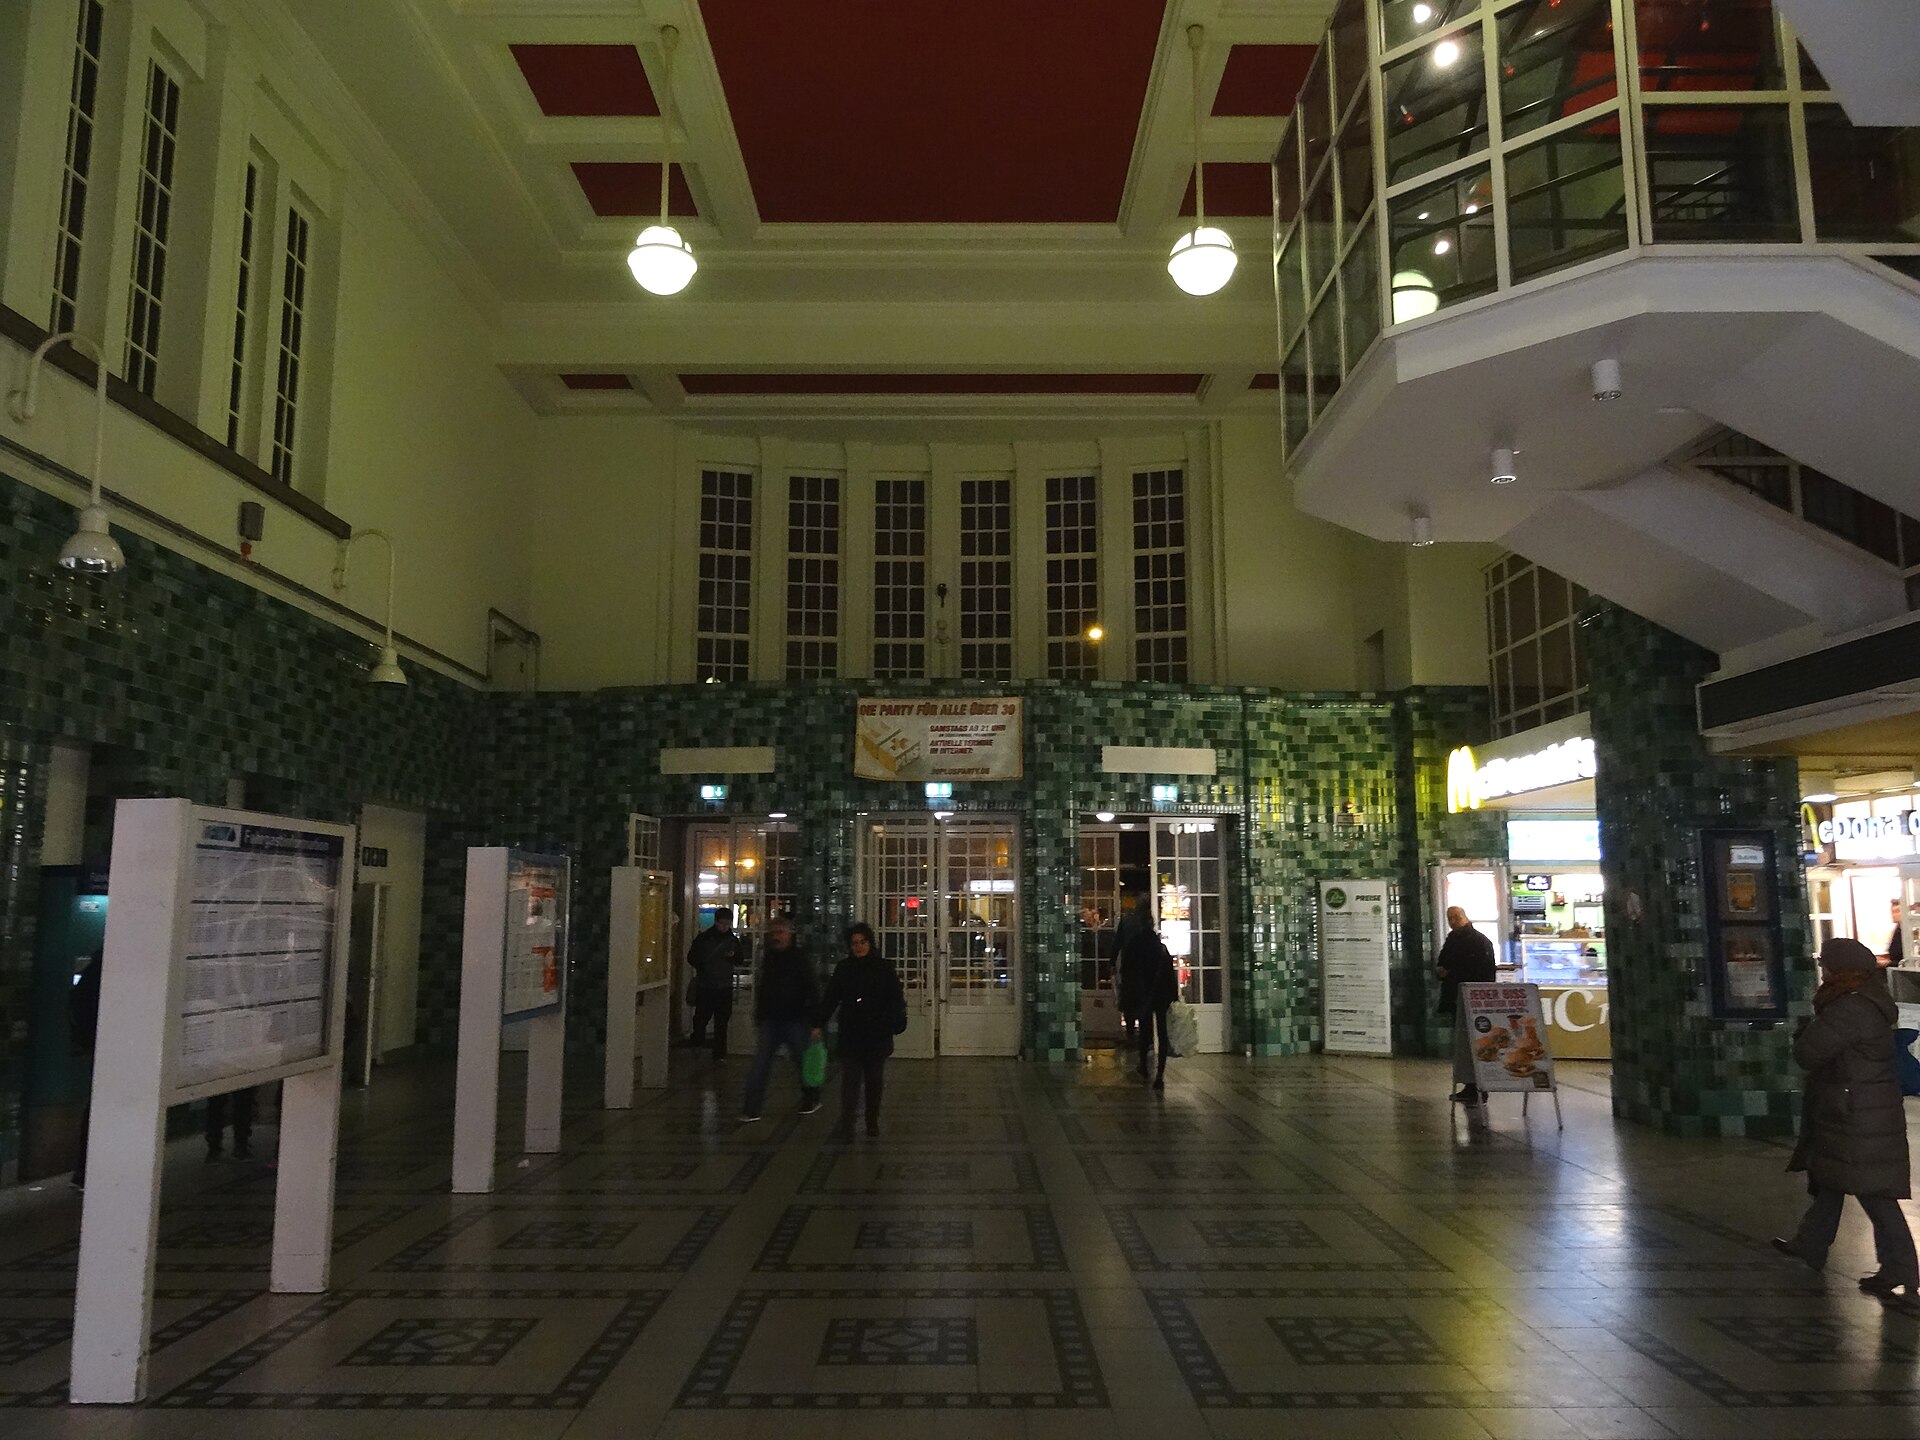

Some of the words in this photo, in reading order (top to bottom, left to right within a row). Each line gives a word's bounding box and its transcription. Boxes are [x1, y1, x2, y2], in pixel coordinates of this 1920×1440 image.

[859, 704, 877, 716] DIE
[879, 703, 914, 716] PARTY
[916, 701, 938, 716] FÜR
[939, 703, 967, 716] ALLE
[969, 701, 998, 716] ÜBER
[1000, 702, 1016, 715] 30
[929, 739, 962, 747] AKTUELLE
[1355, 894, 1382, 902] PREISE
